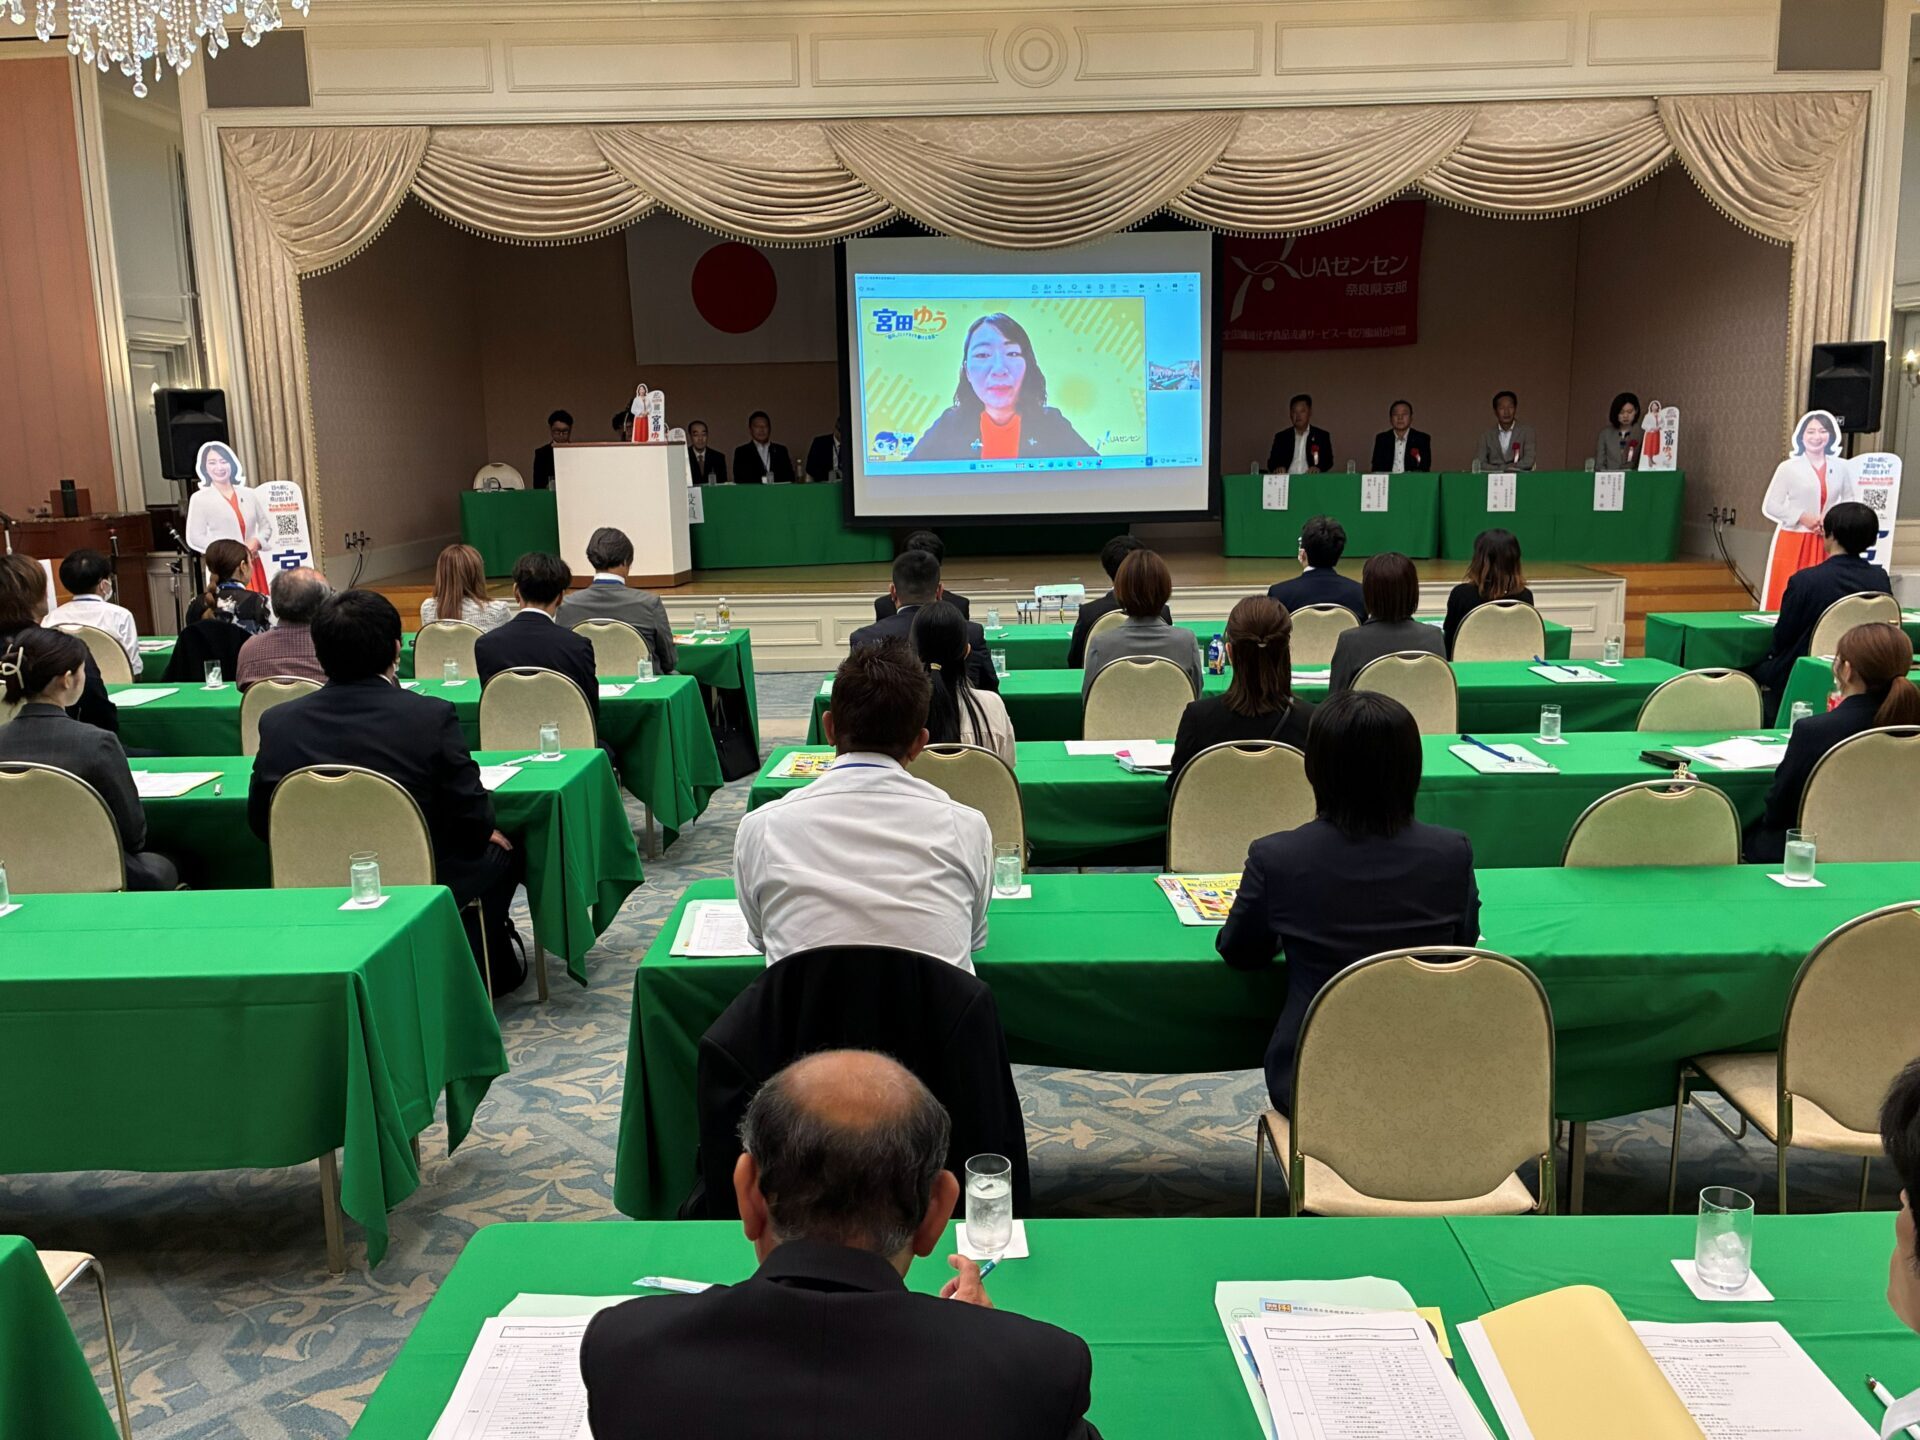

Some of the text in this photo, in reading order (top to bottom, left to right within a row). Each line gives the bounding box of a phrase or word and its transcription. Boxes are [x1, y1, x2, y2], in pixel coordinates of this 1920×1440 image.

[1299, 255, 1409, 278] UAゼンセン
[1344, 280, 1408, 297] 奈良県支部
[873, 305, 947, 332] 宮田ゆう
